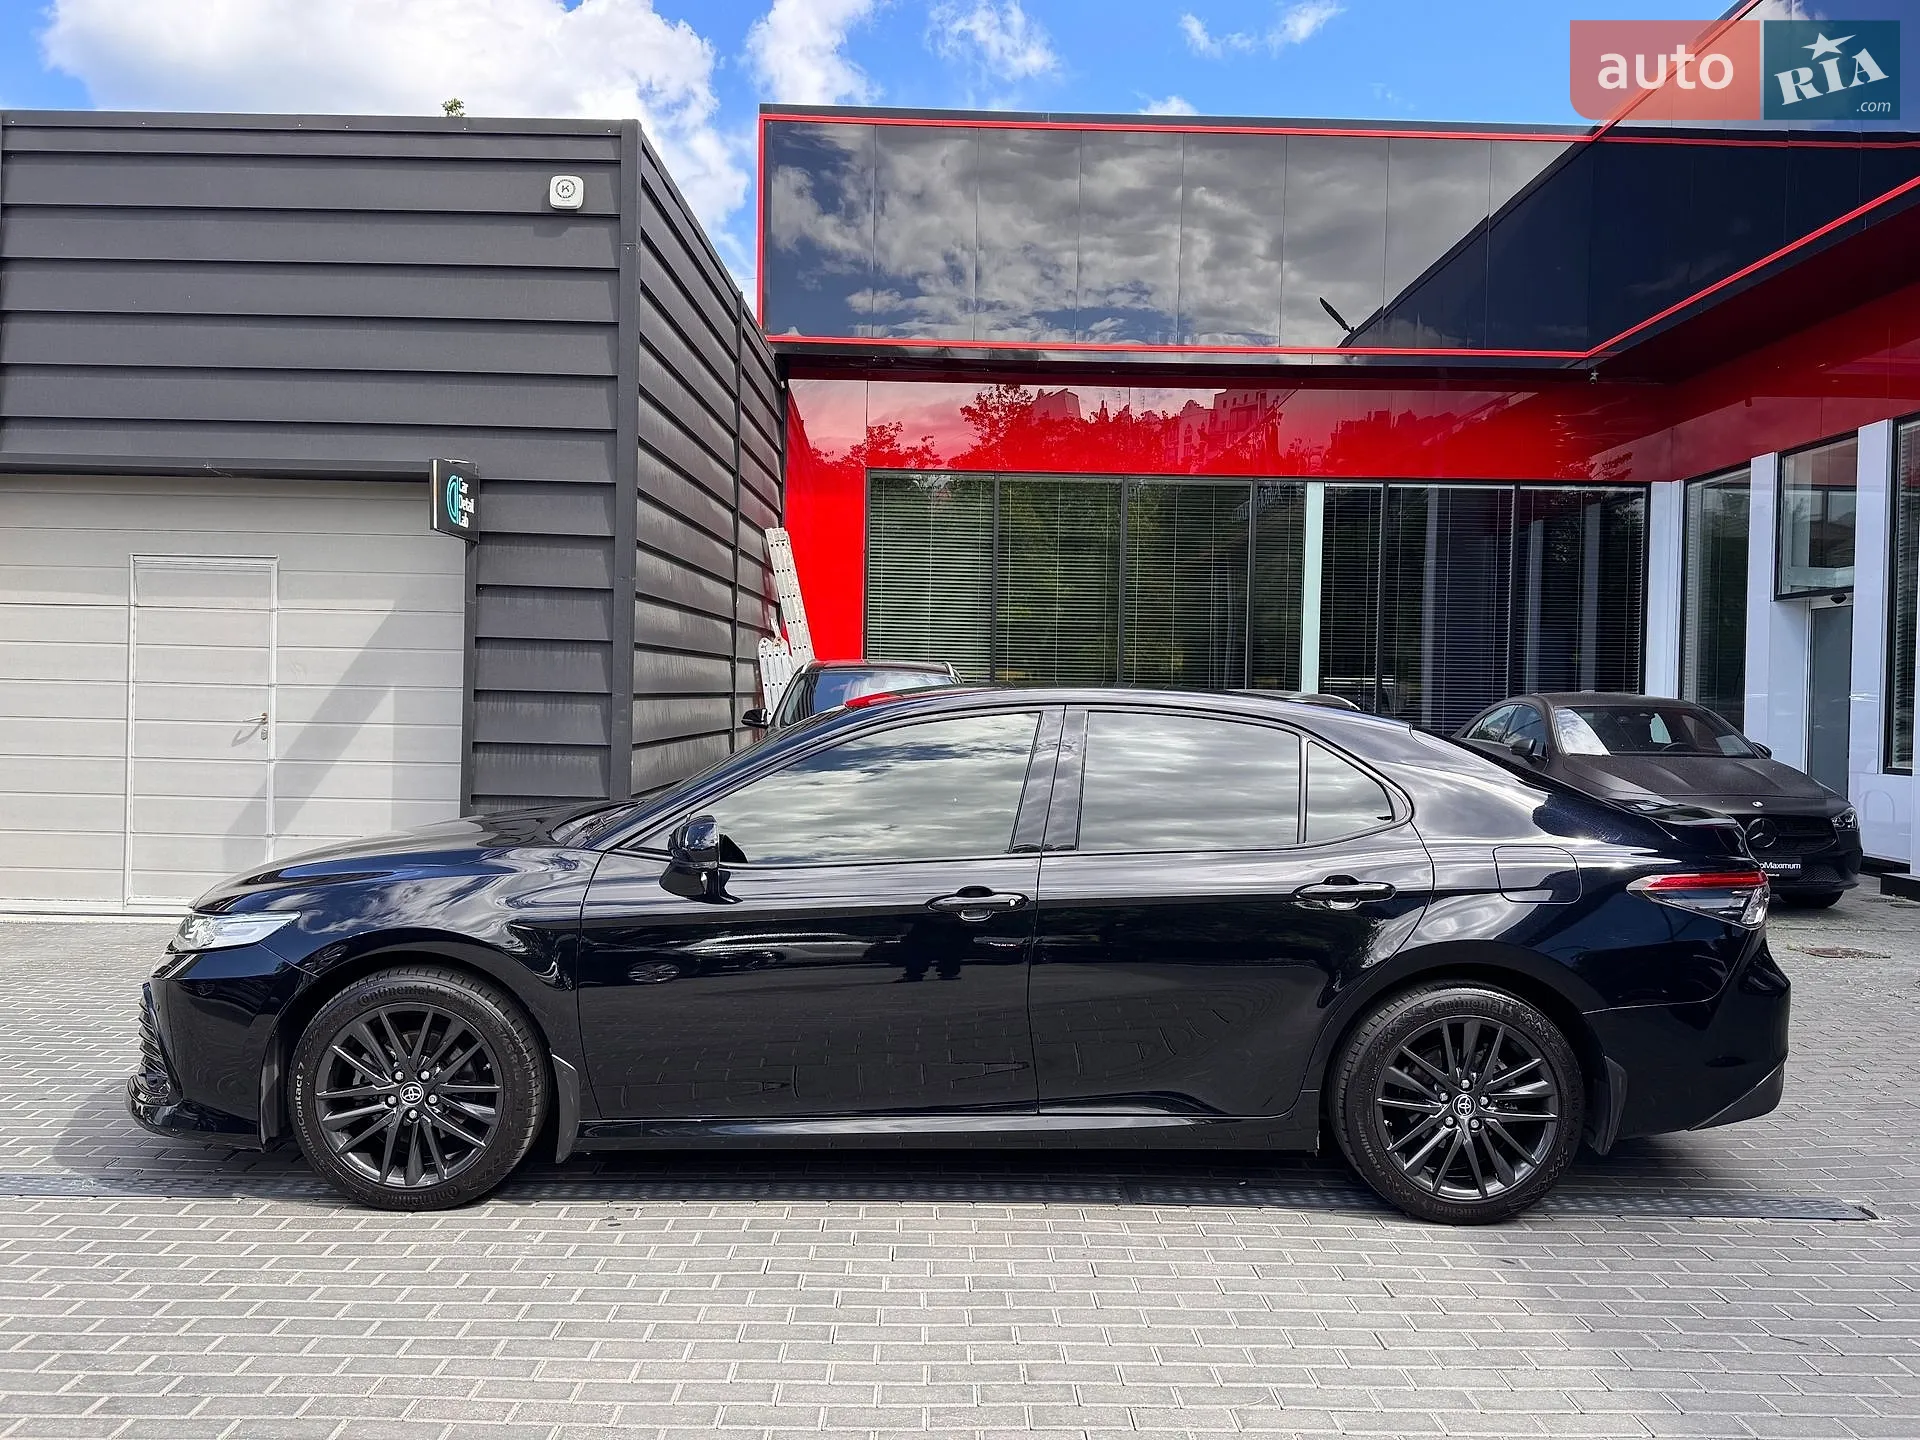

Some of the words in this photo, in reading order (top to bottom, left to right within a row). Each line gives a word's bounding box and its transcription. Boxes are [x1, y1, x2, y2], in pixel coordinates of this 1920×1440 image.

[459, 477, 468, 494] Car
[459, 494, 474, 513] Detail
[459, 511, 469, 528] Lab
